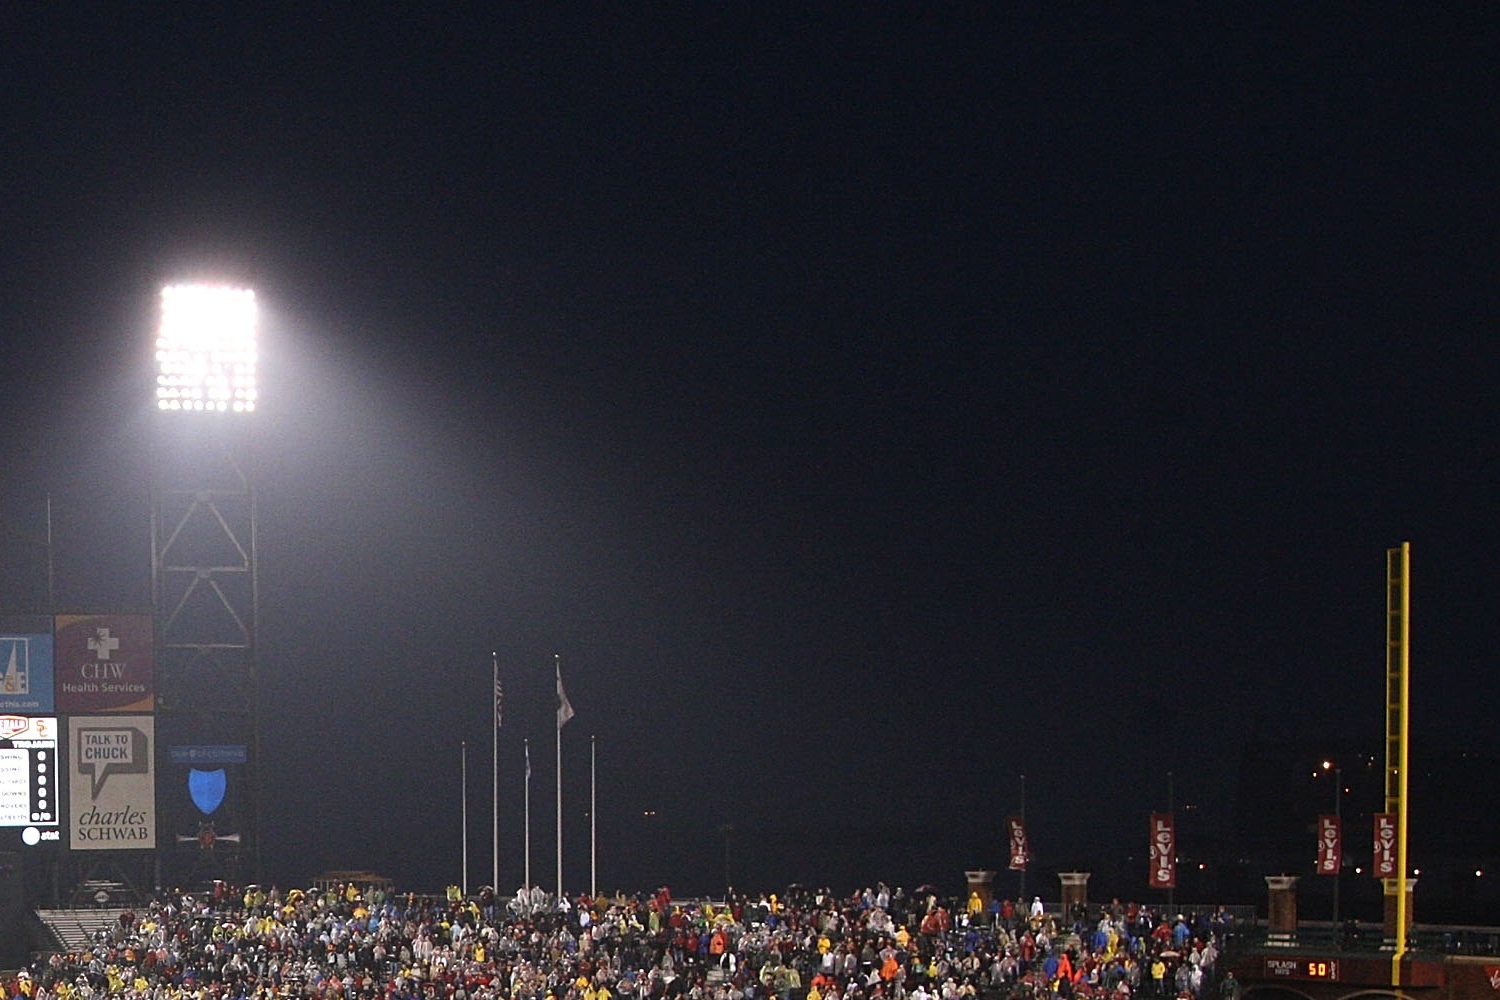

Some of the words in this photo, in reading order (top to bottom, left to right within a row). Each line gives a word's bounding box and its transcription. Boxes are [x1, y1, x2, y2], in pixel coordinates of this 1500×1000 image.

[81, 662, 126, 679] CHW
[62, 682, 99, 693] Health
[102, 682, 145, 693] Services
[85, 735, 111, 744] TALK
[115, 735, 128, 744] TO
[85, 747, 128, 760] CHUCK
[79, 805, 146, 825] charles
[78, 827, 148, 841] SCHWAB
[1268, 960, 1296, 969] SPLASH
[1309, 963, 1326, 975] 50
